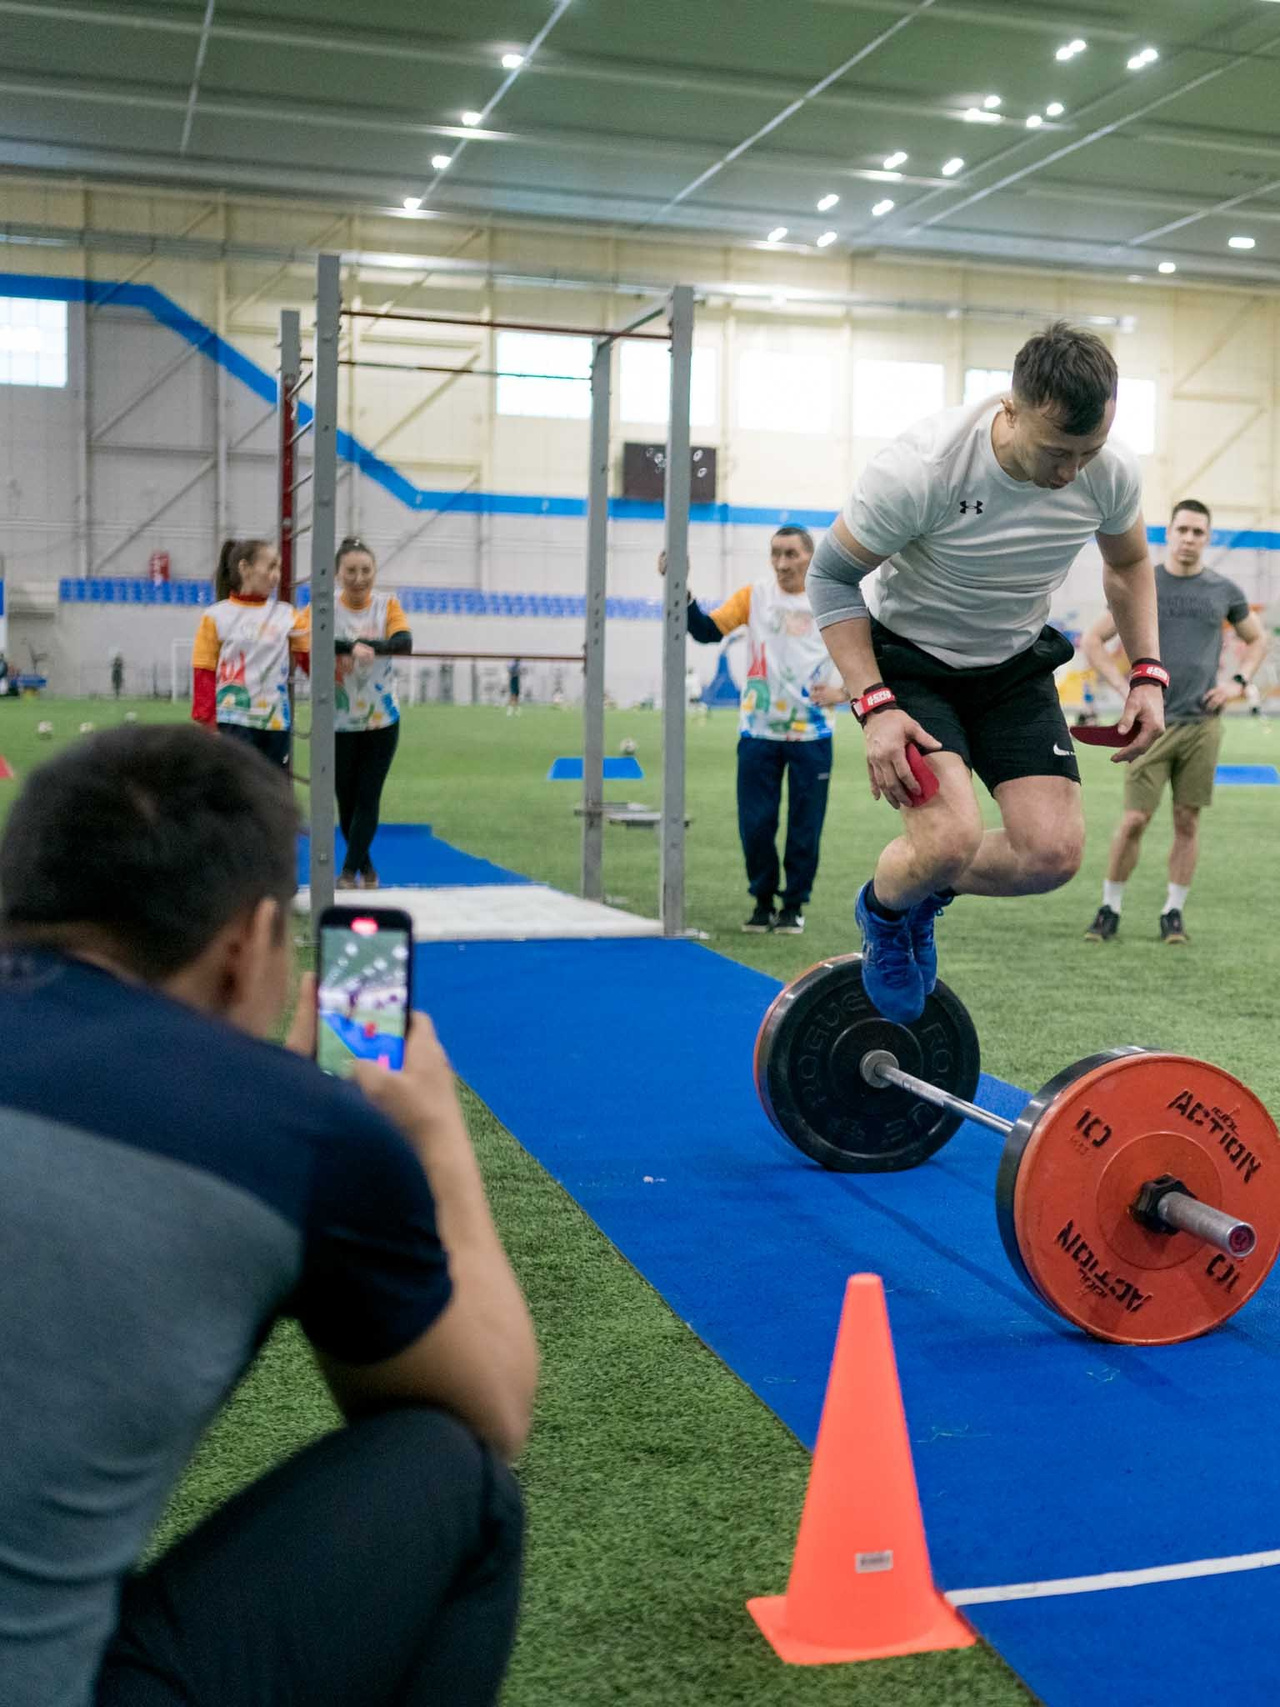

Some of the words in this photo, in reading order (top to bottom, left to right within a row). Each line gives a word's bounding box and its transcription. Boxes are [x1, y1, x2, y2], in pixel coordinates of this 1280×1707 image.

[1076, 1110, 1112, 1147] 10
[1167, 1090, 1261, 1184] ACTION
[1055, 1220, 1147, 1312] ACTION
